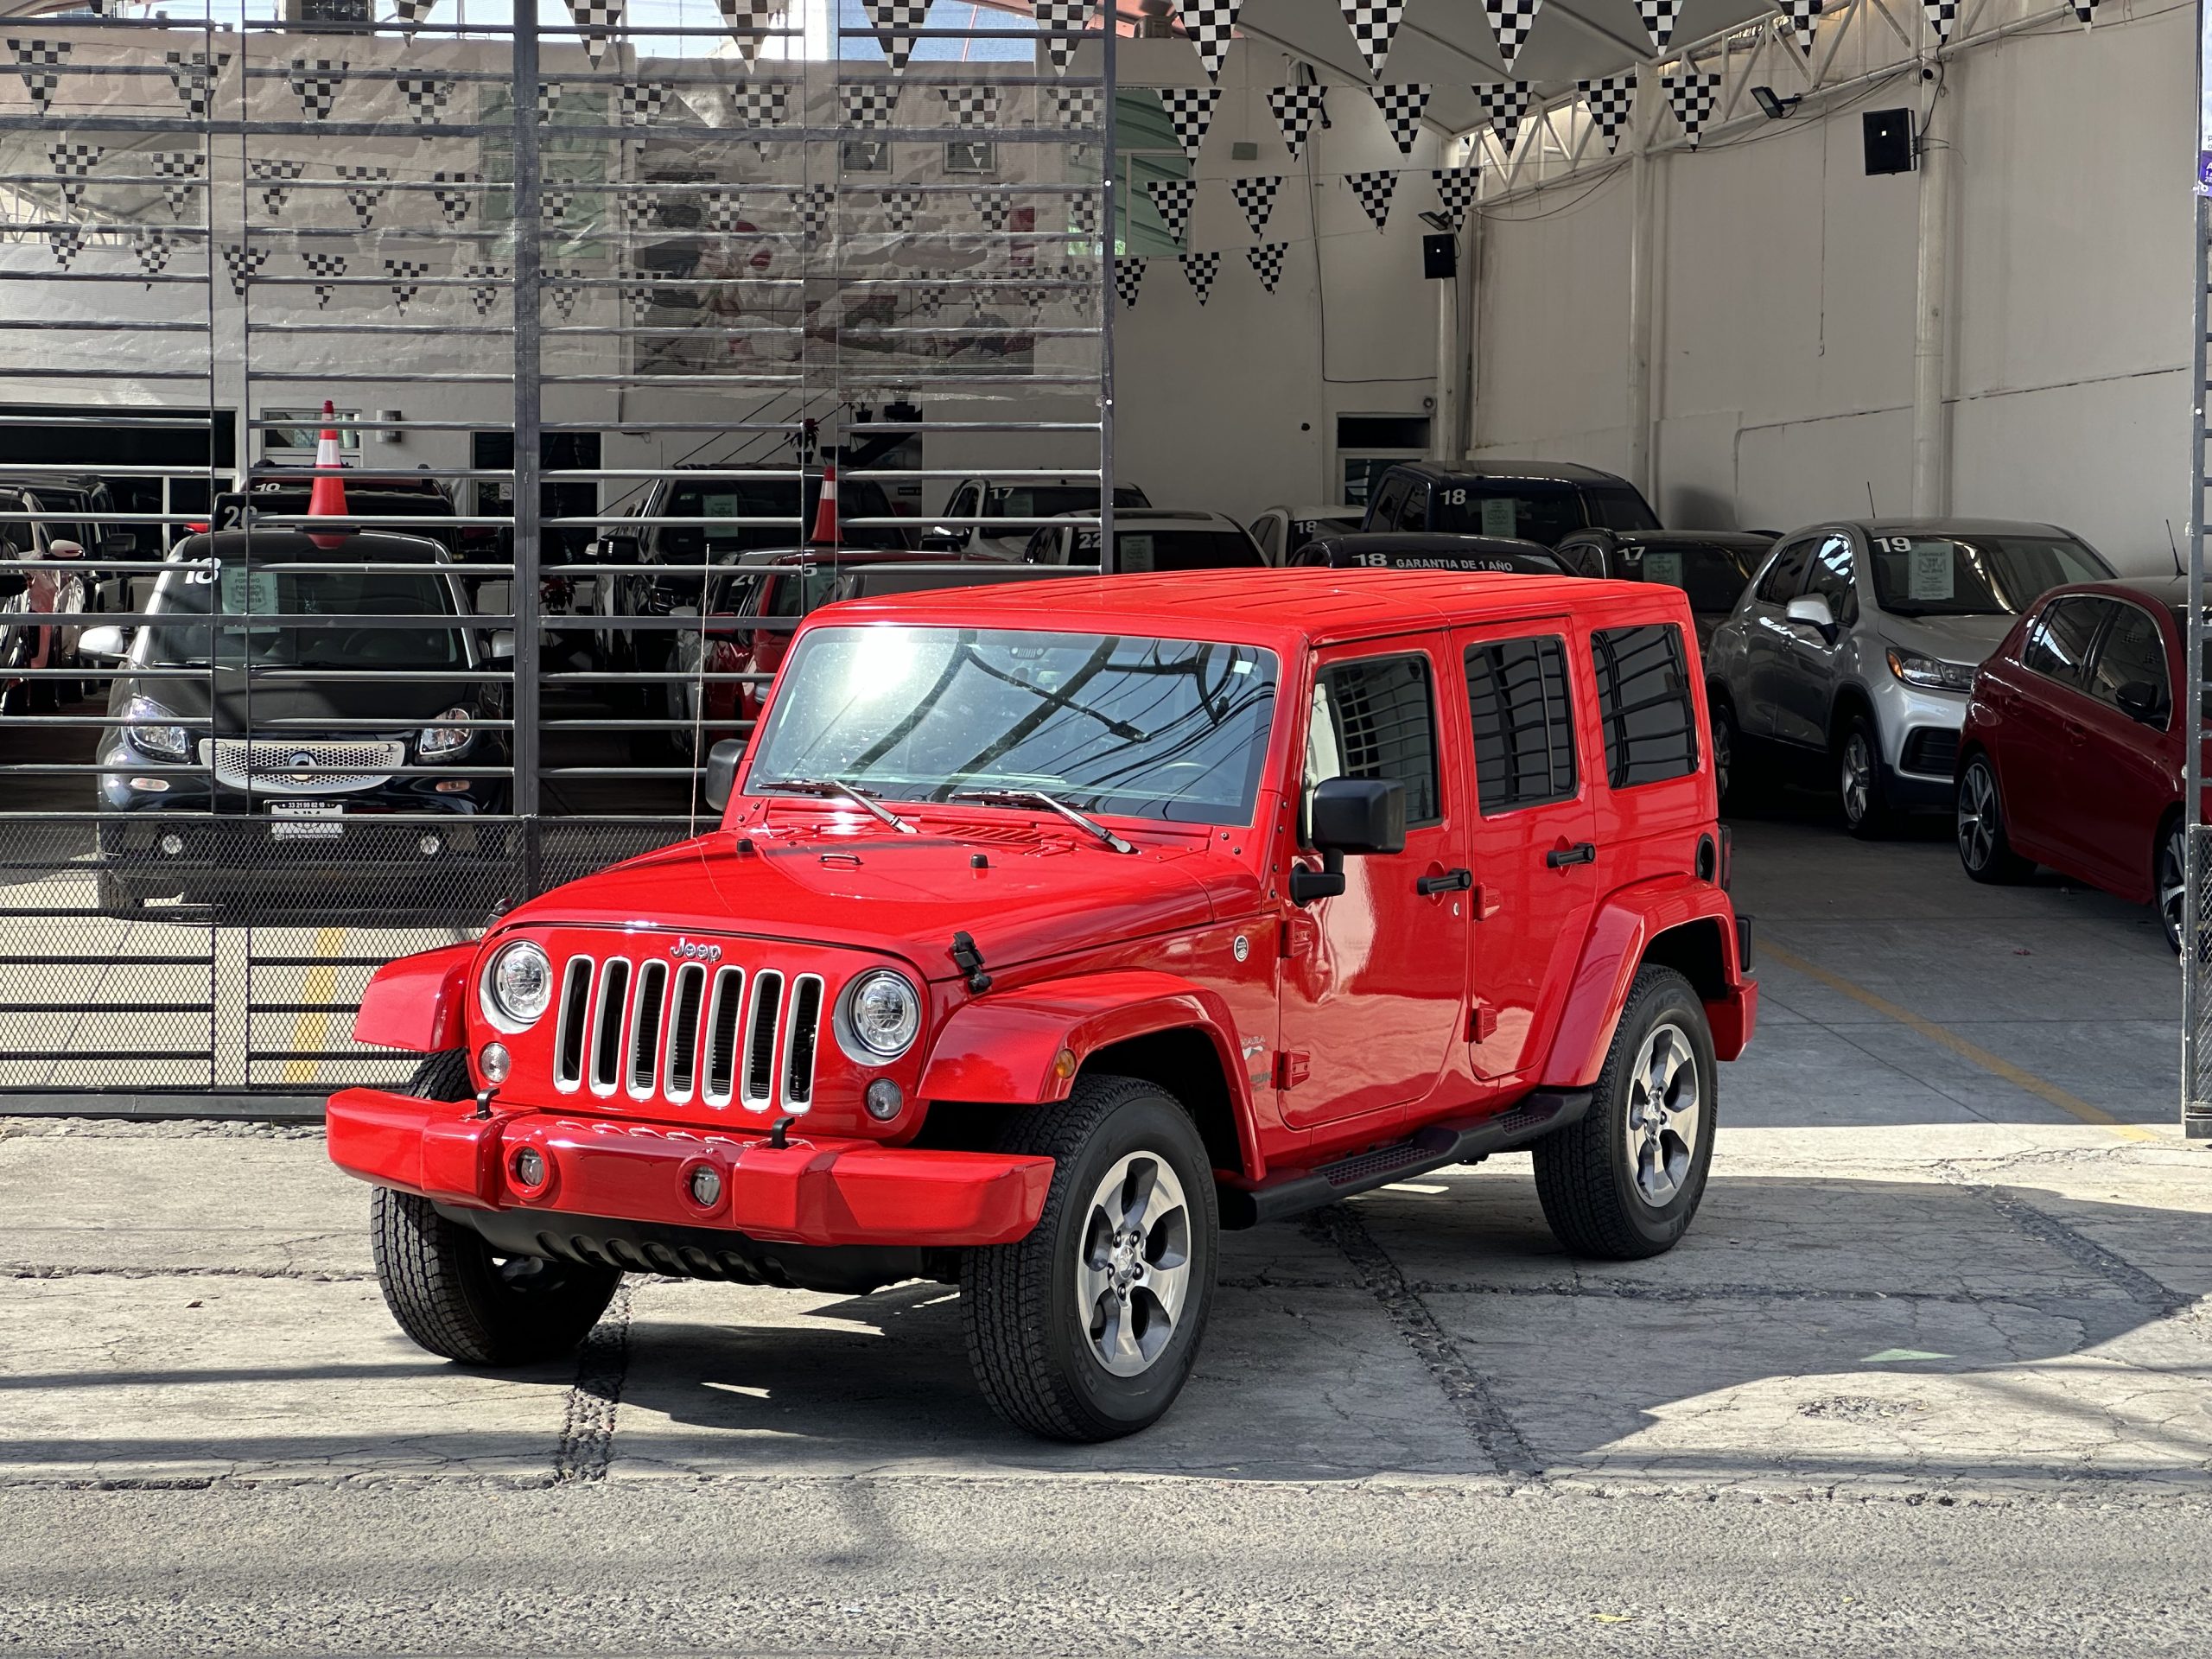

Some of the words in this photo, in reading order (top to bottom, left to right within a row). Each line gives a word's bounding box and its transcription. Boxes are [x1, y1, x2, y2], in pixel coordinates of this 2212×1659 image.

[989, 487, 1014, 499] 17
[1440, 488, 1466, 505] 18
[1294, 520, 1318, 534] 18
[1873, 537, 1911, 552] 19
[1351, 553, 1387, 567] 18
[1618, 546, 1645, 561] 17
[1395, 558, 1459, 569] GARANTIA
[1460, 560, 1477, 569] DE
[1478, 561, 1485, 569] 1
[1489, 559, 1513, 571] AÑO
[671, 937, 721, 964] Jeep
